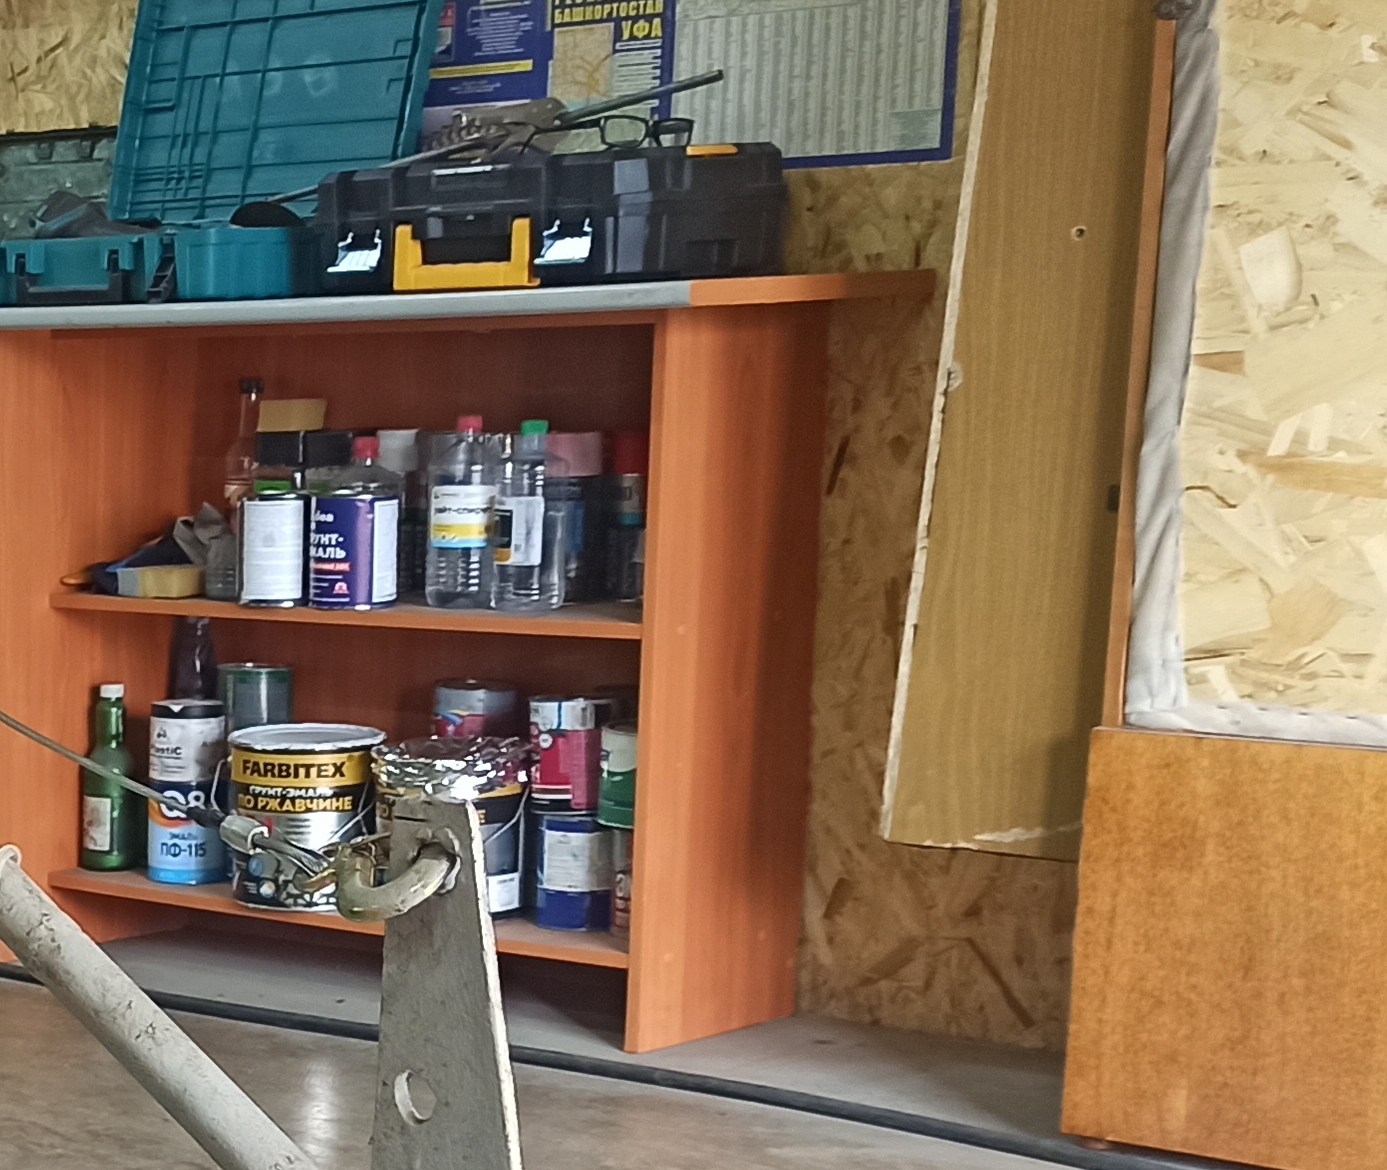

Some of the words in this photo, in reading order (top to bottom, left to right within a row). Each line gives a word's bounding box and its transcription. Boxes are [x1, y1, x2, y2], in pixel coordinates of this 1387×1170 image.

[554, 1, 664, 24] БАШКОРТОСТАН
[621, 17, 663, 40] УФА
[242, 759, 347, 779] FARBITEX
[249, 785, 334, 798] ГРУНТ-ЭМАЛЬ
[238, 793, 255, 808] ПО
[257, 795, 353, 812] РЖАВЧИНЕ
[160, 842, 207, 858] ПФ-115
